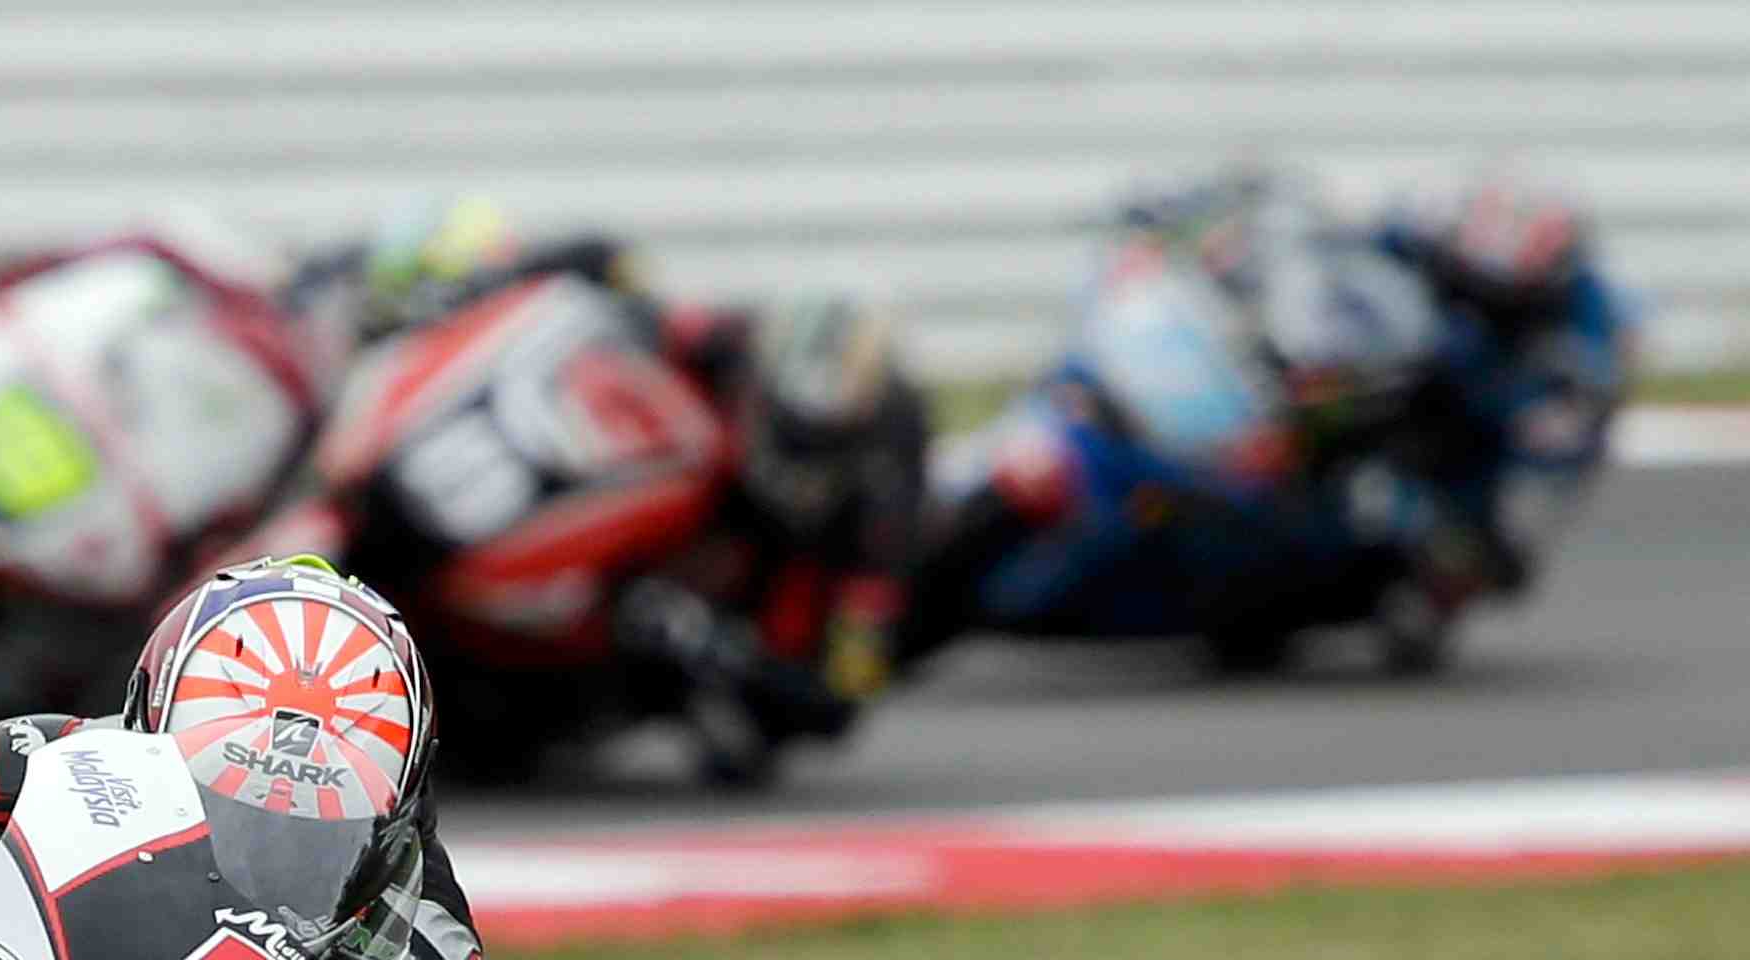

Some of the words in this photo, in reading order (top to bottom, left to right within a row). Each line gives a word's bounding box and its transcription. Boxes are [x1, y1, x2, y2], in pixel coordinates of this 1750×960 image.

[221, 741, 348, 788] SHARK
[58, 749, 120, 828] Malaysia
[105, 777, 144, 814] Visit
